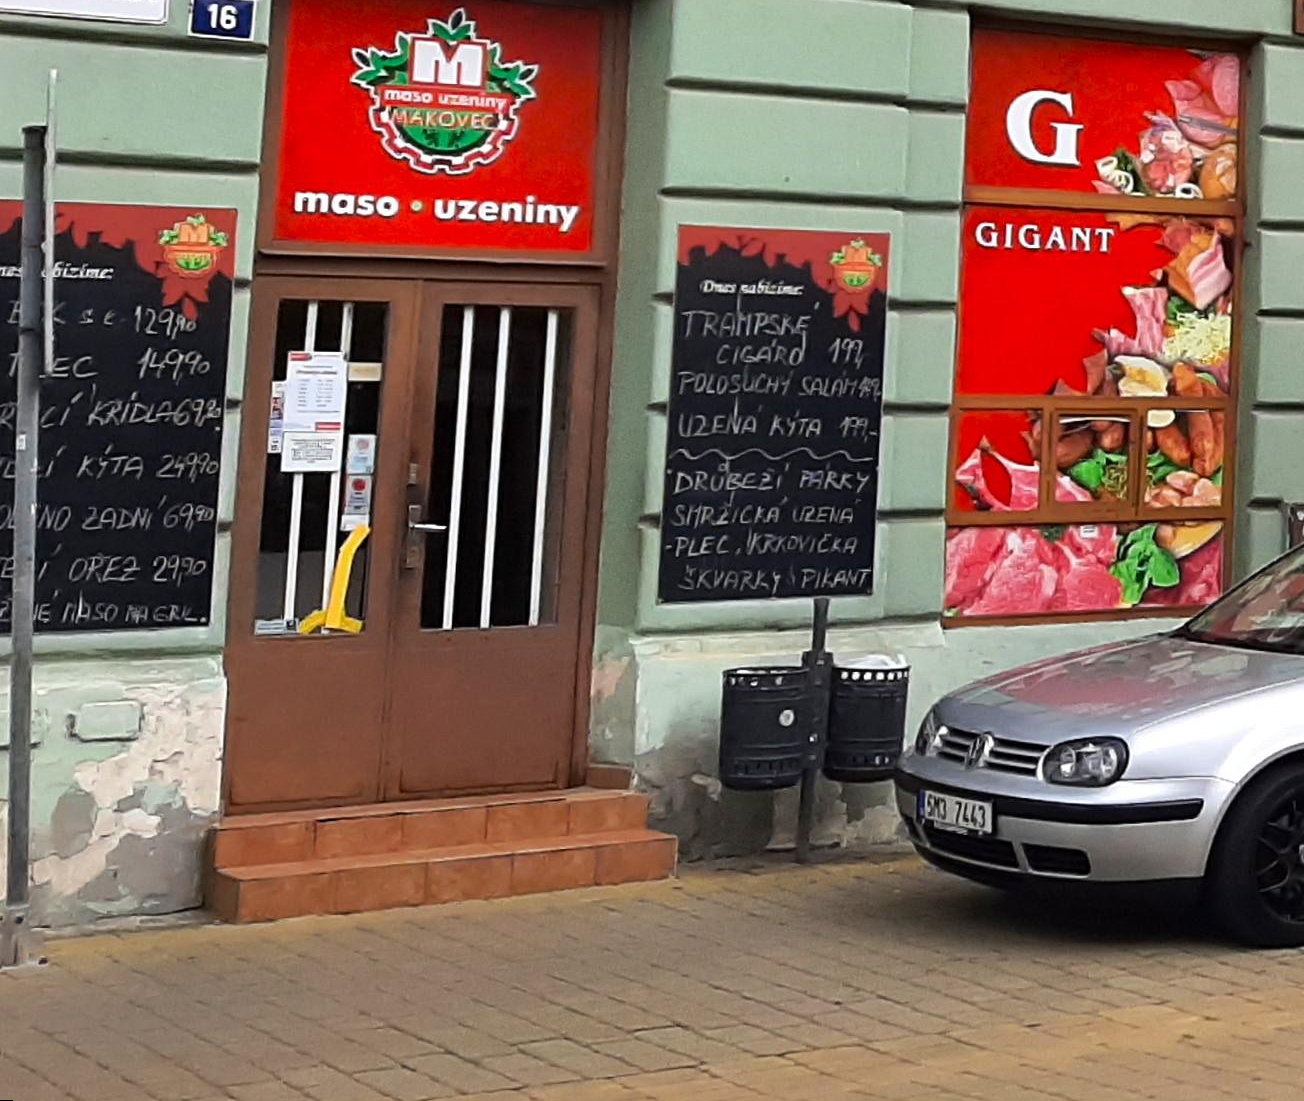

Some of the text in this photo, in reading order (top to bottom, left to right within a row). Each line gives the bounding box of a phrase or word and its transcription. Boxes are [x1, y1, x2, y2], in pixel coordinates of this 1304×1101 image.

[207, 4, 237, 30] 16
[412, 39, 484, 87] M
[384, 89, 508, 111] maso uzeniny
[392, 110, 497, 130] MAKOVEC
[1006, 89, 1084, 166] G
[294, 189, 579, 231] maso uzeniny
[975, 222, 1115, 253] GIGANT
[955, 800, 985, 828] 7443
